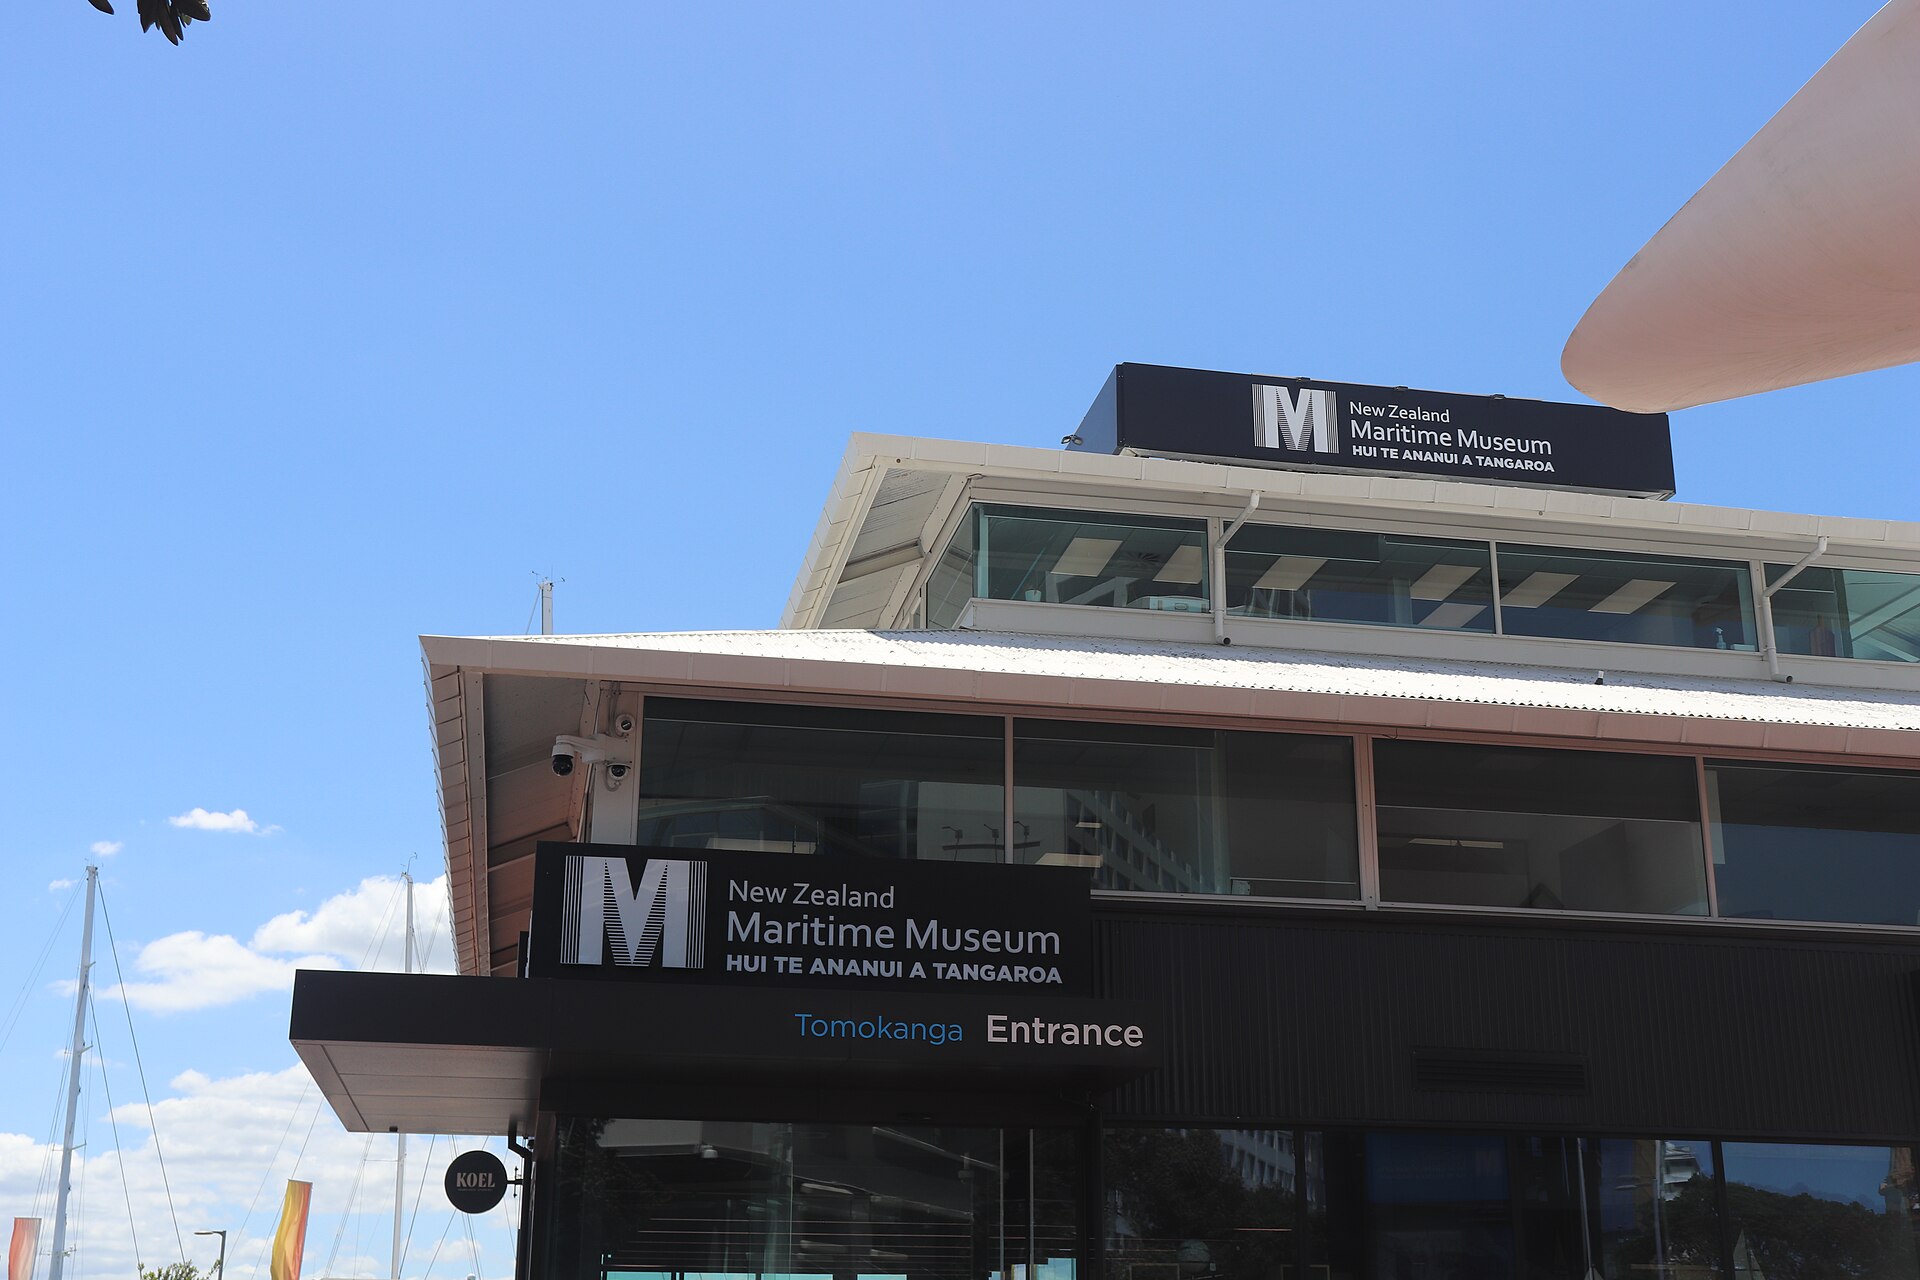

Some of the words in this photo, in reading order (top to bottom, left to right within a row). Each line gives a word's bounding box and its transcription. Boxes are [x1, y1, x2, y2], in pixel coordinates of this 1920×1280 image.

[1349, 401, 1386, 417] New
[1387, 404, 1450, 423] Zealand
[1350, 419, 1452, 447] Maritime
[1457, 428, 1552, 455] Museum
[1352, 444, 1378, 458] HUI
[1380, 447, 1399, 460] TE
[1401, 449, 1459, 465] ANANUI
[1461, 454, 1474, 466] A
[1475, 455, 1555, 473] TANGAROA
[729, 879, 787, 904] New
[792, 882, 895, 909] Zealand
[726, 910, 895, 949] Maritime
[906, 918, 1060, 955] Museum
[726, 954, 767, 973] HUI
[773, 956, 803, 974] TE
[809, 957, 903, 978] ANANUI
[909, 961, 927, 979] A
[932, 962, 1063, 984] TANGAROA
[795, 1013, 963, 1045] Tomokanga
[987, 1014, 1144, 1048] Entrance
[456, 1172, 495, 1188] KOEL
